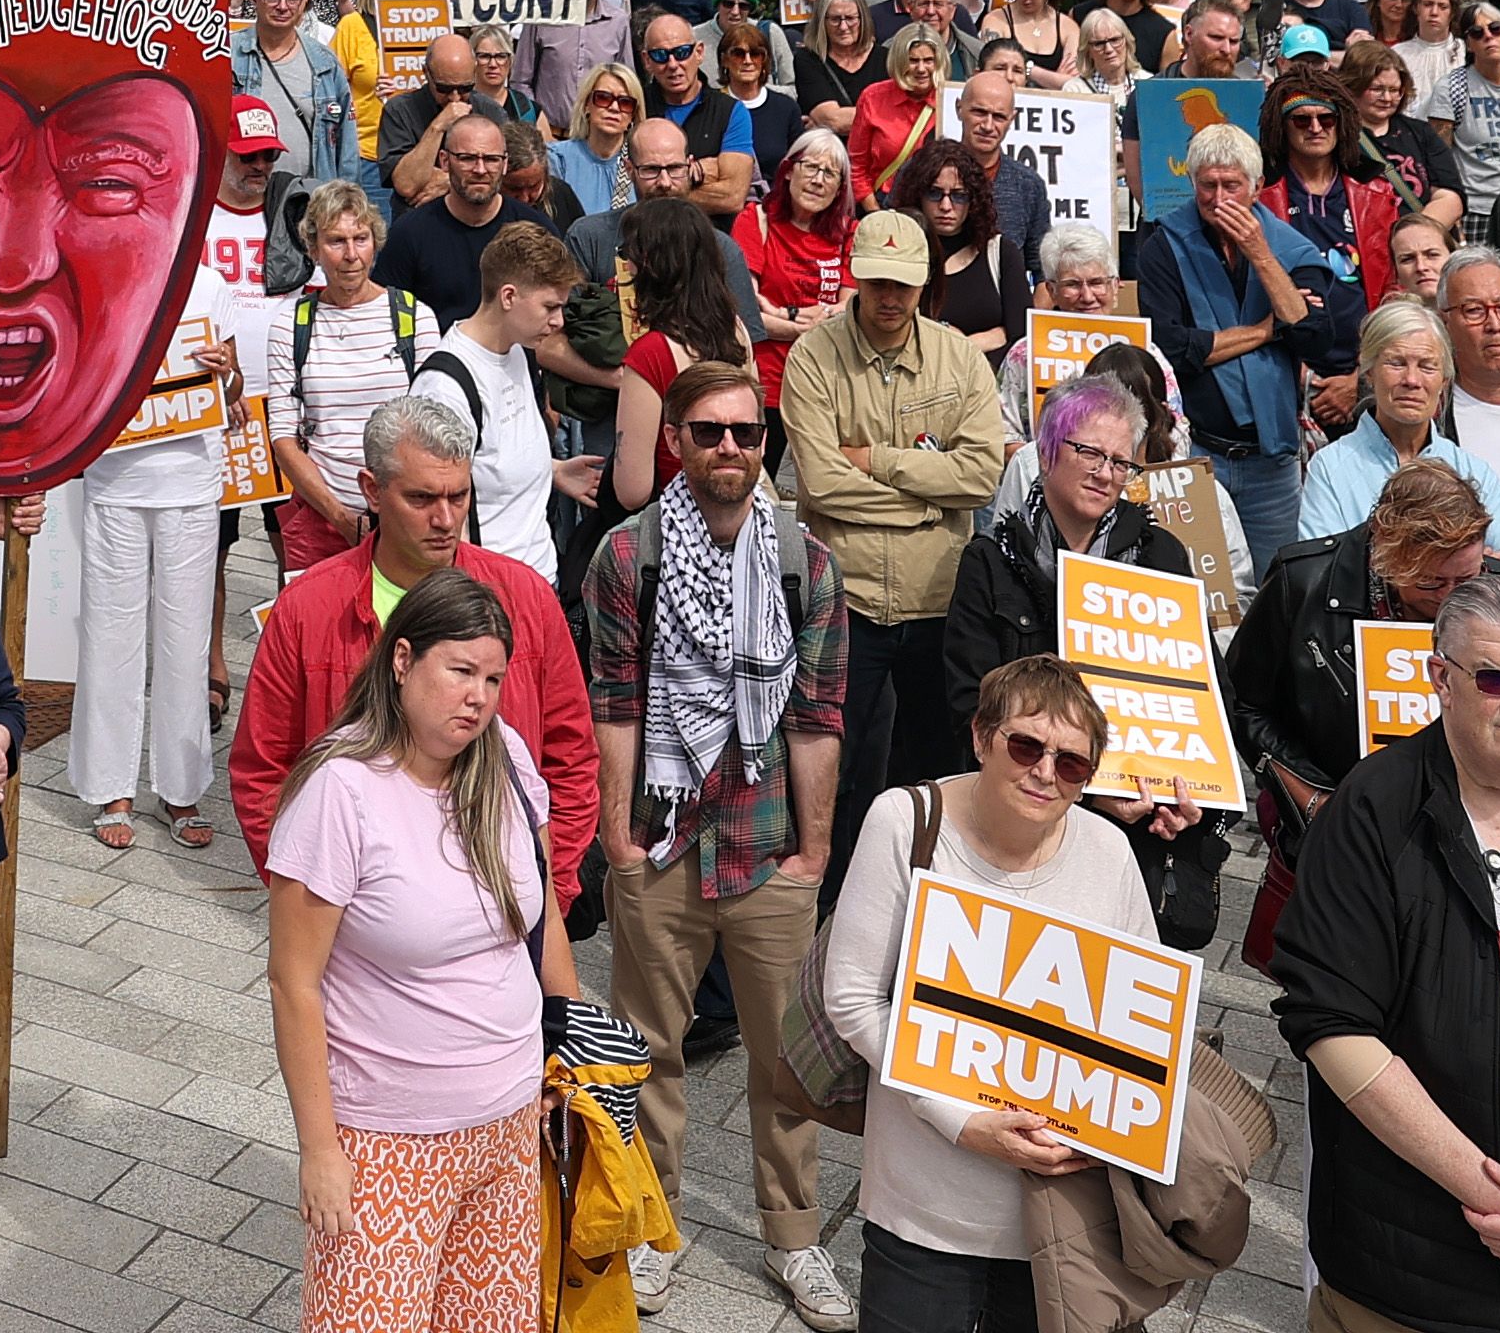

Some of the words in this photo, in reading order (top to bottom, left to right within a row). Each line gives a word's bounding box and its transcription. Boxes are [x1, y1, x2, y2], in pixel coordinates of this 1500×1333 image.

[388, 6, 439, 24] STOP
[1081, 581, 1181, 628] STOP
[1066, 619, 1203, 672] TRUMP
[915, 887, 1181, 1061] NAE
[907, 1007, 1160, 1137] TRUMP
